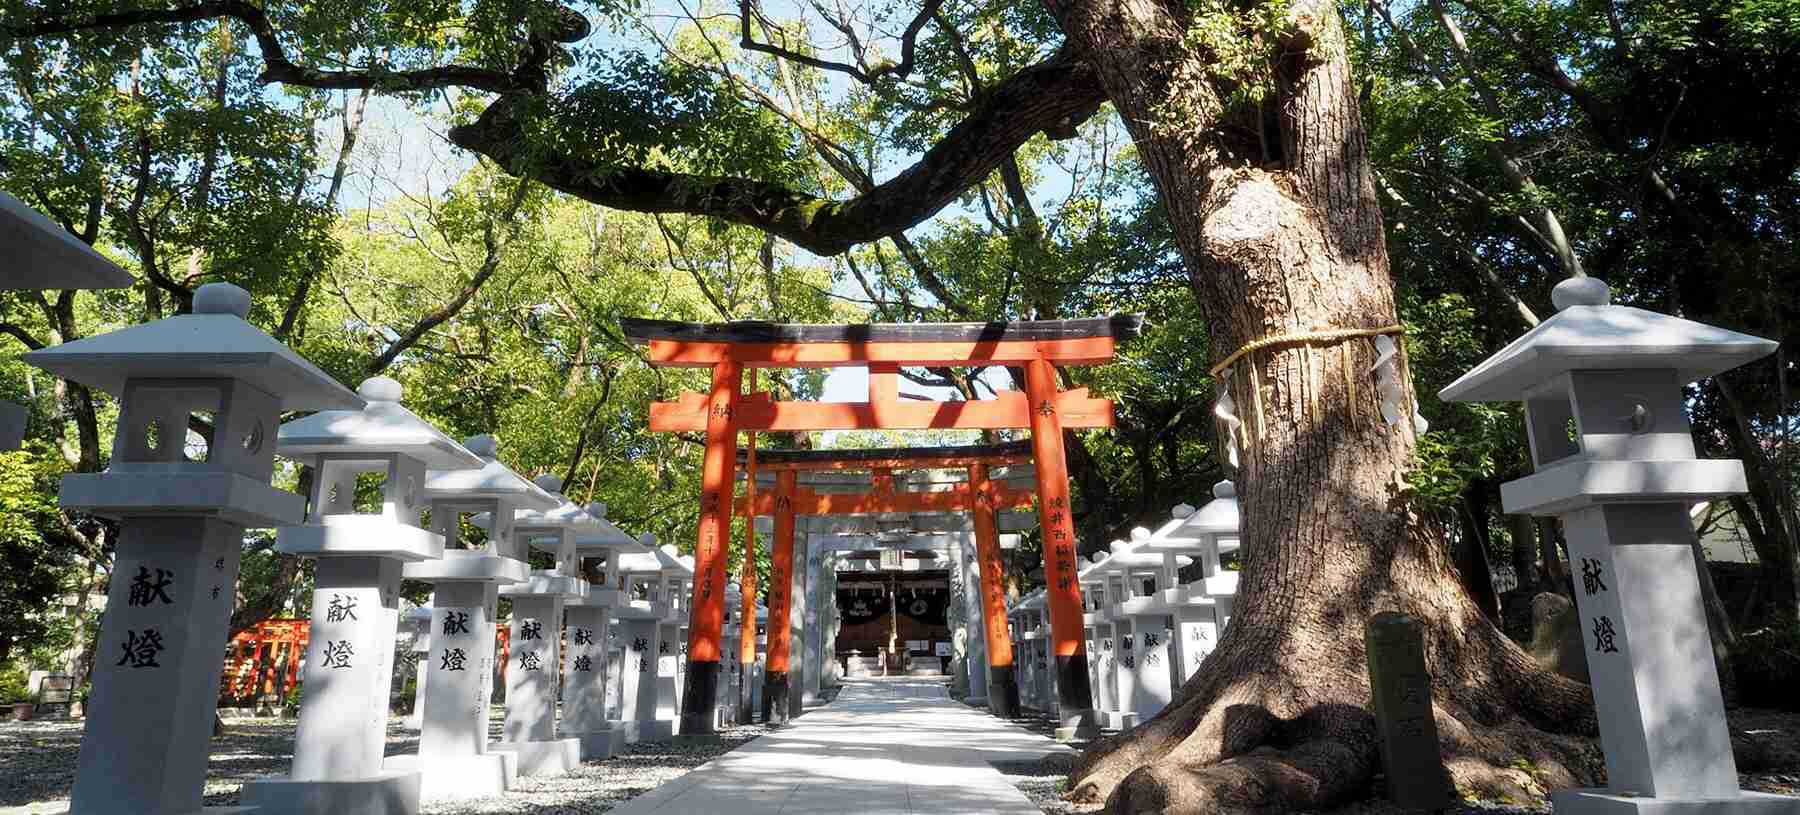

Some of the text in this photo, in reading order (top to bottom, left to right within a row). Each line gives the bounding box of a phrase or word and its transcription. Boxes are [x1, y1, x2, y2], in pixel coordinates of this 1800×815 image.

[117, 566, 175, 668] 献燈
[322, 594, 359, 670] 献燈
[1581, 557, 1618, 654] 献燈
[440, 611, 469, 672] 献燈
[519, 620, 541, 671] 献燈
[574, 628, 593, 672] 献燈
